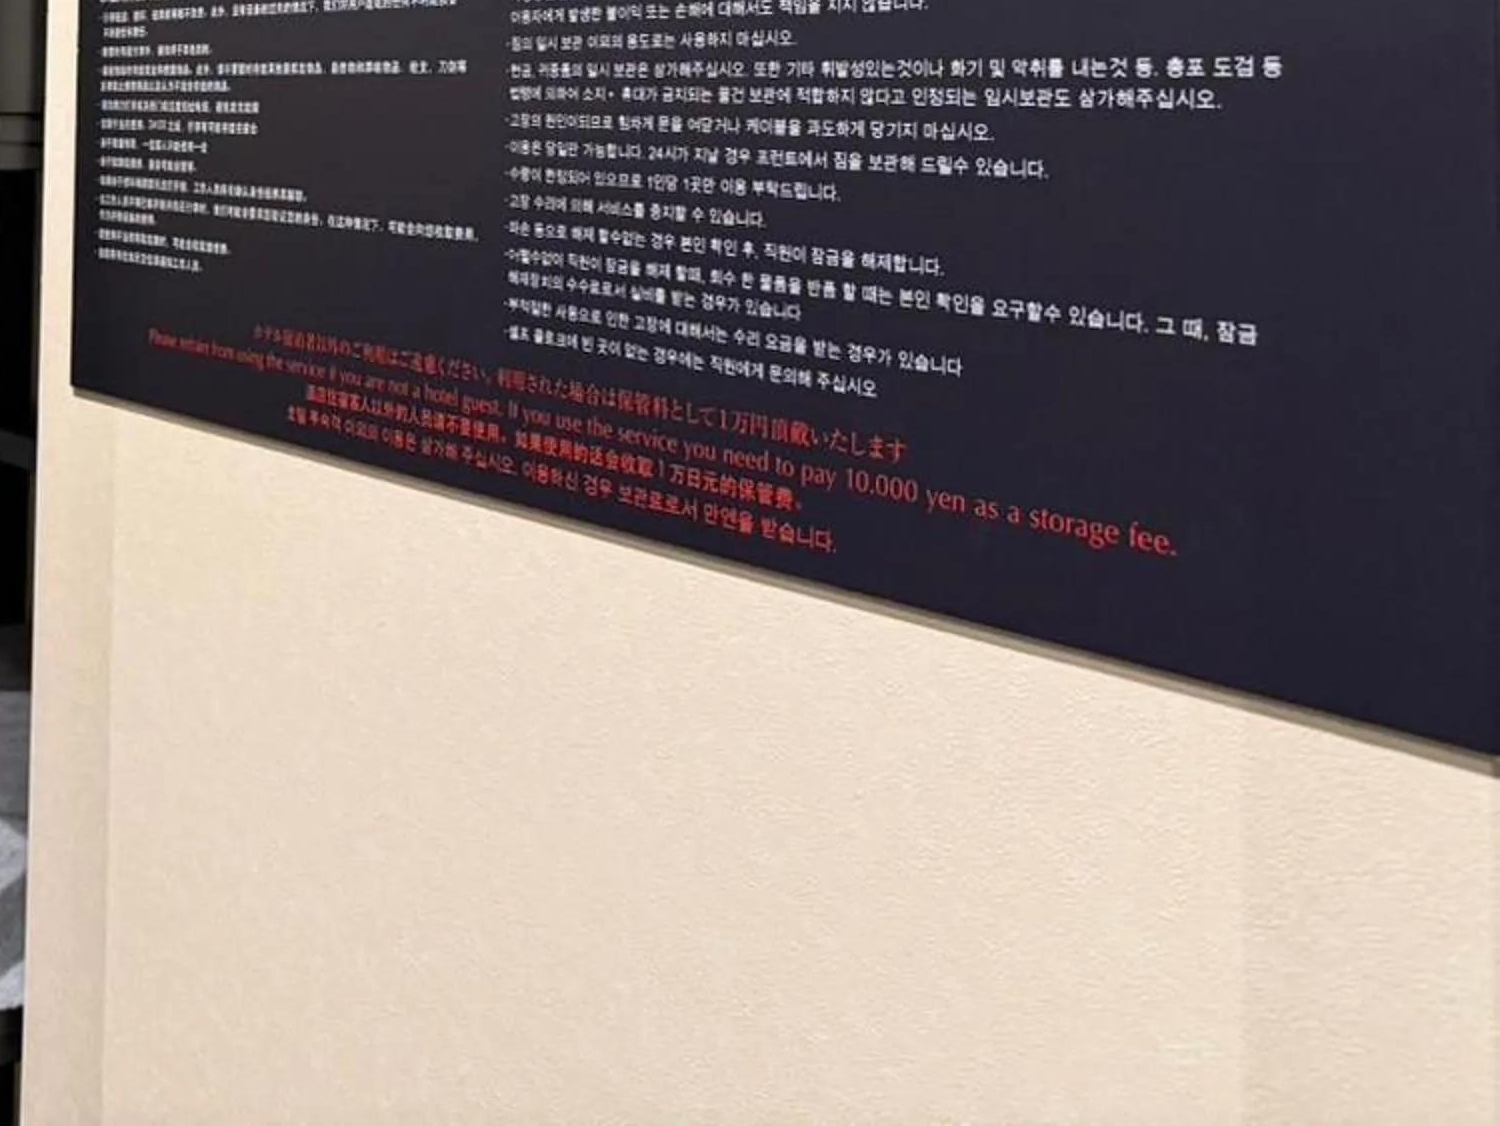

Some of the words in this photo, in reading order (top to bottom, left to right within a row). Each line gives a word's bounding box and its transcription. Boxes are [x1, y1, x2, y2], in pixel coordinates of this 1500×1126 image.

[424, 384, 458, 404] hotel
[508, 401, 518, 419] If
[522, 408, 551, 425] you
[556, 416, 582, 433] use
[587, 417, 613, 439] the
[618, 428, 677, 454] service
[684, 441, 717, 461] you
[723, 449, 769, 471] need
[776, 457, 795, 477] to
[801, 464, 837, 491] pay
[847, 468, 918, 502] 10.000
[926, 489, 968, 513] yen
[974, 499, 999, 519] as
[1007, 505, 1021, 524] a
[1030, 508, 1120, 550] storage
